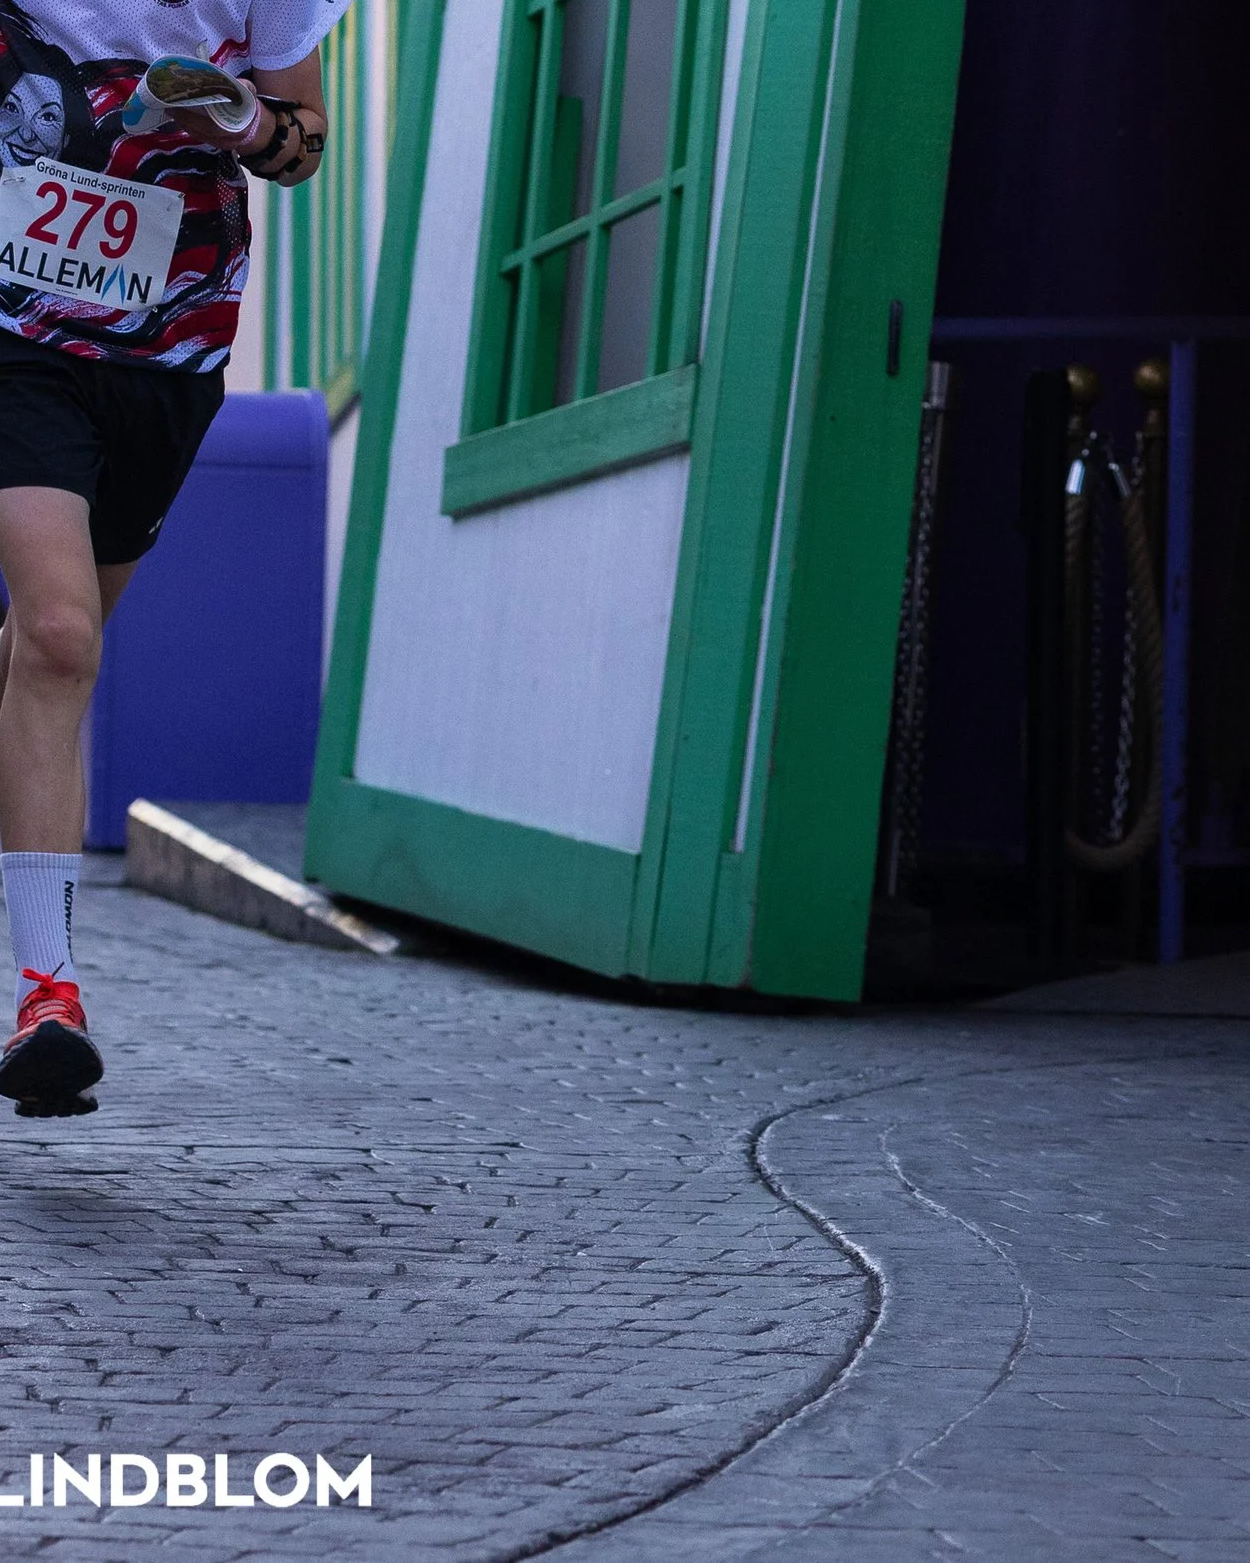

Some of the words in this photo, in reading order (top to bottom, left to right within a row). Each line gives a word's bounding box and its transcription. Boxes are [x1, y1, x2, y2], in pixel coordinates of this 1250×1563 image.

[36, 160, 68, 180] Gröna
[70, 171, 146, 200] Lund-sprinten
[24, 181, 138, 260] 279
